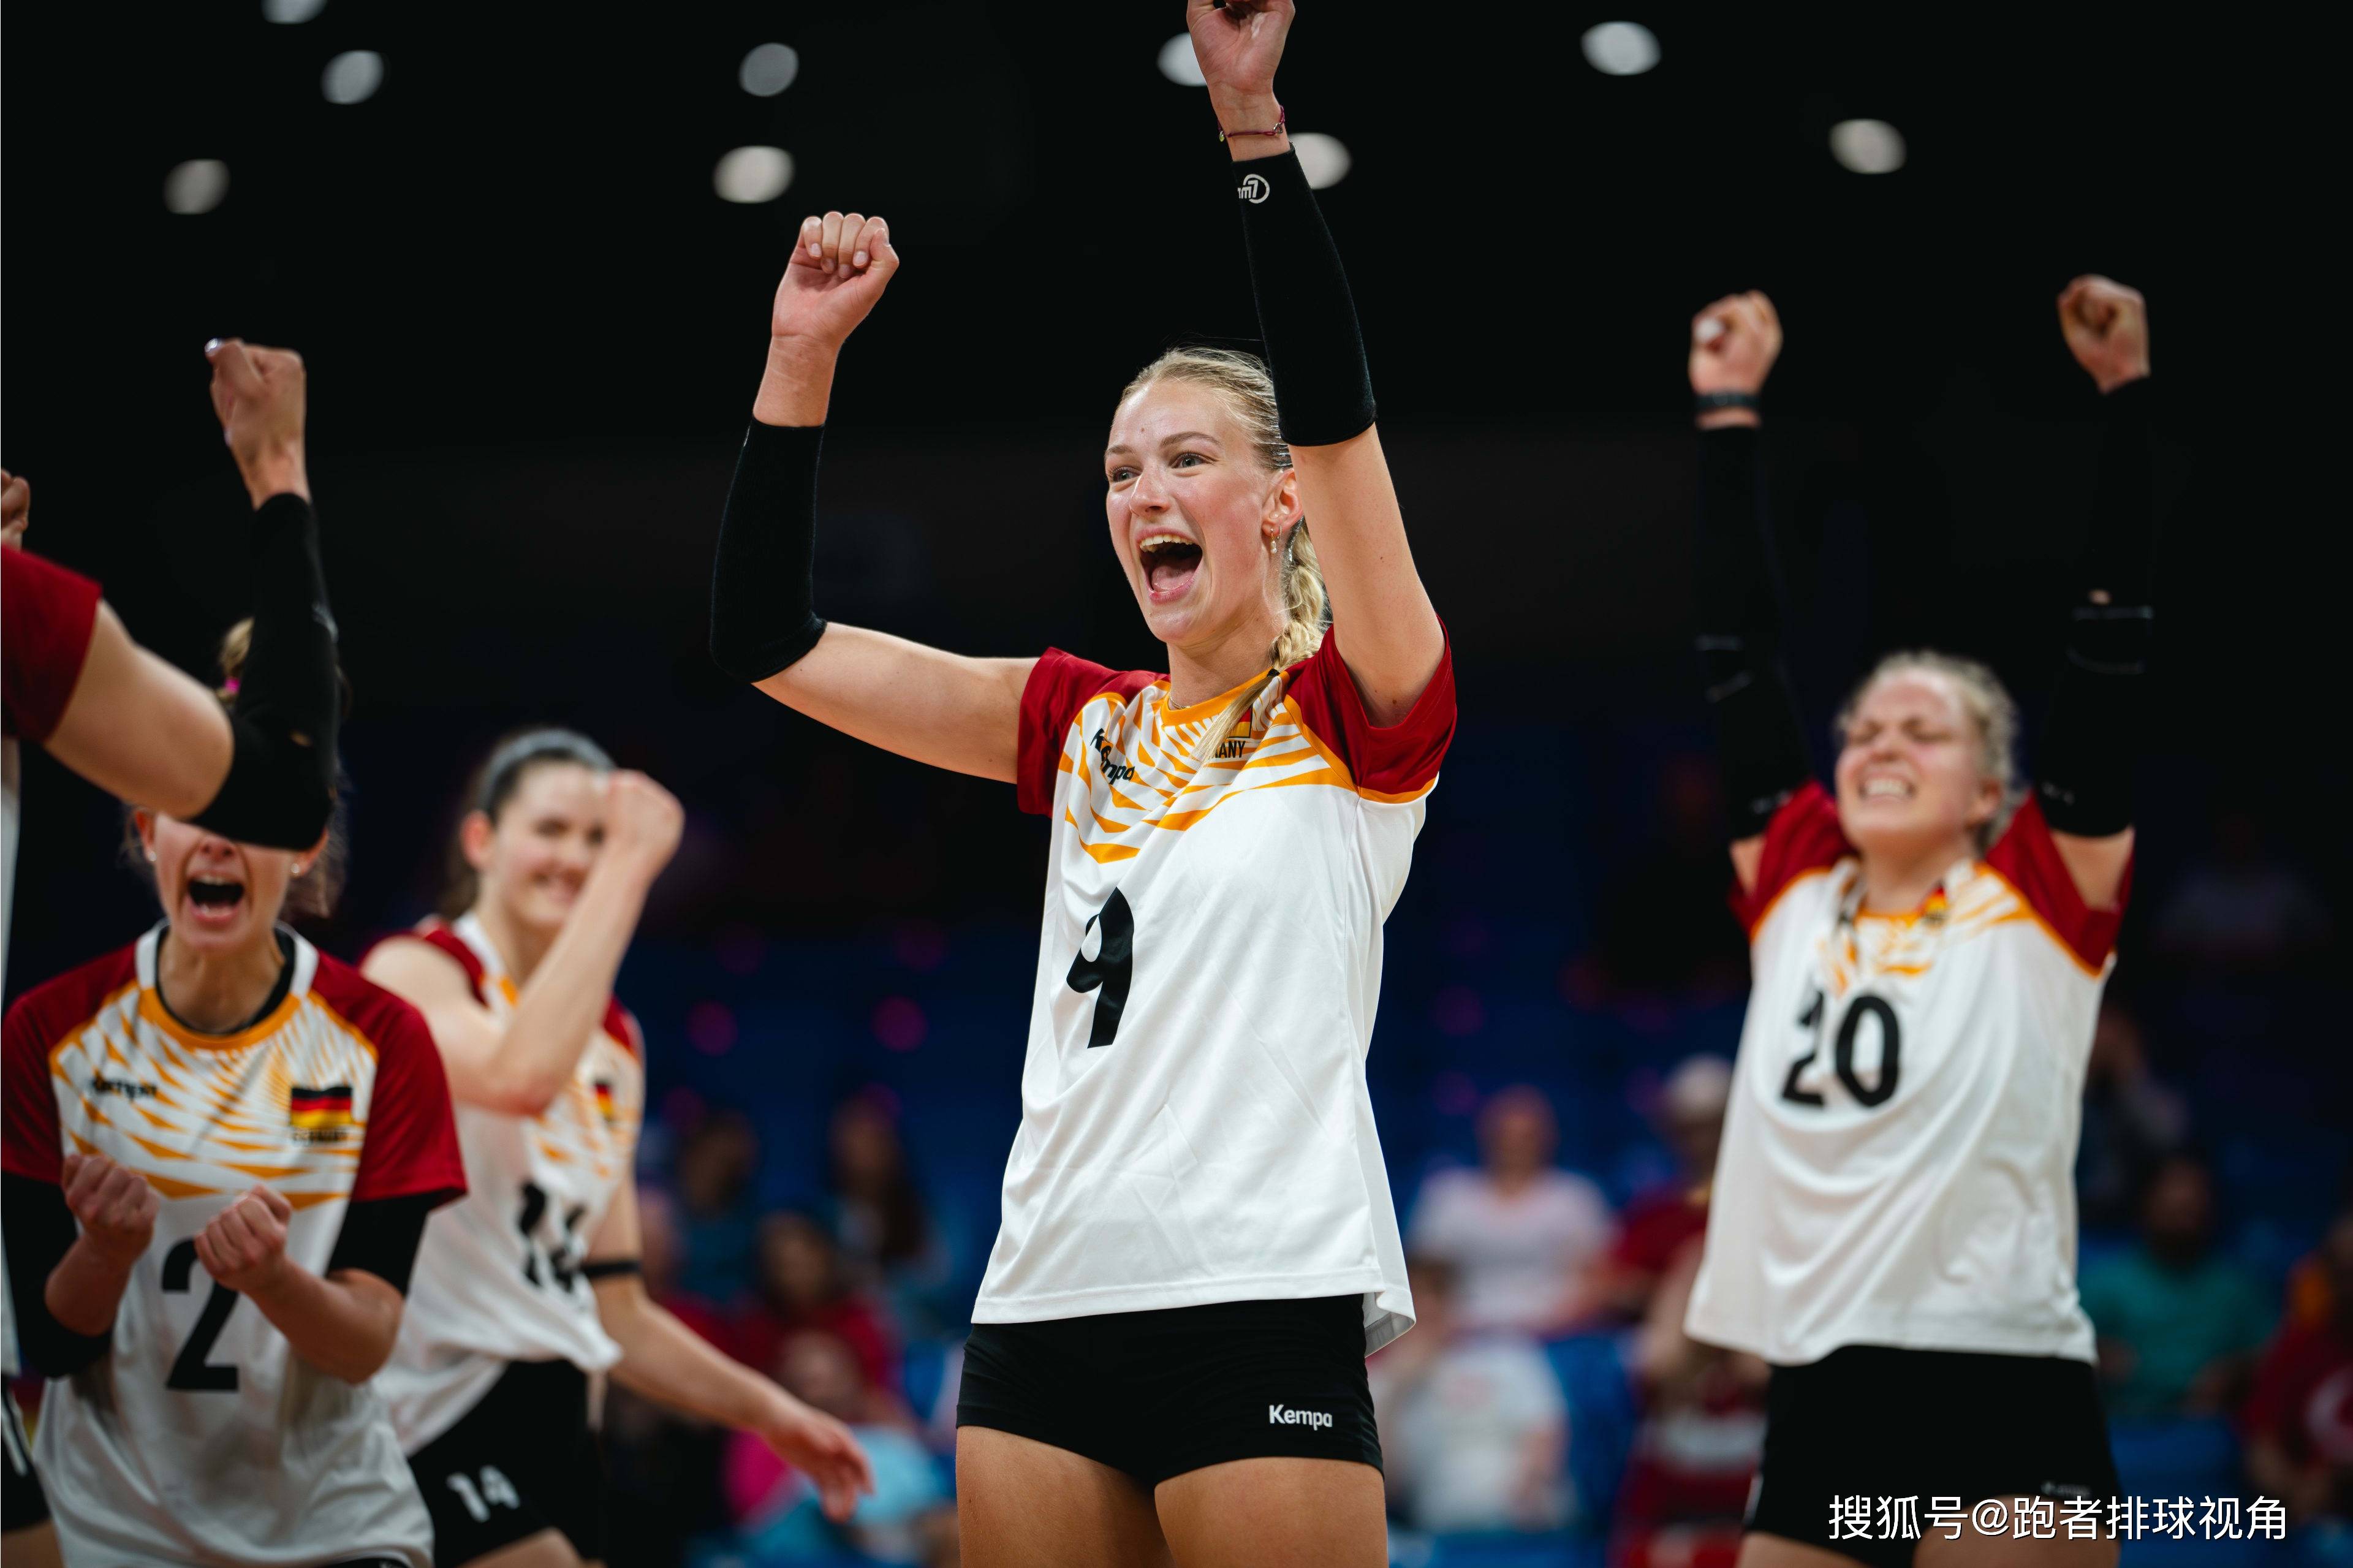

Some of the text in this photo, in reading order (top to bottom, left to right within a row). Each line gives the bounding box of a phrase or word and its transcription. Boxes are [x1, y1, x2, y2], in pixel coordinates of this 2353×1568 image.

[1781, 990, 1900, 1108] 20
[161, 1237, 240, 1392] 2
[1269, 1404, 1333, 1431] Kempa
[447, 1465, 520, 1523] 14
